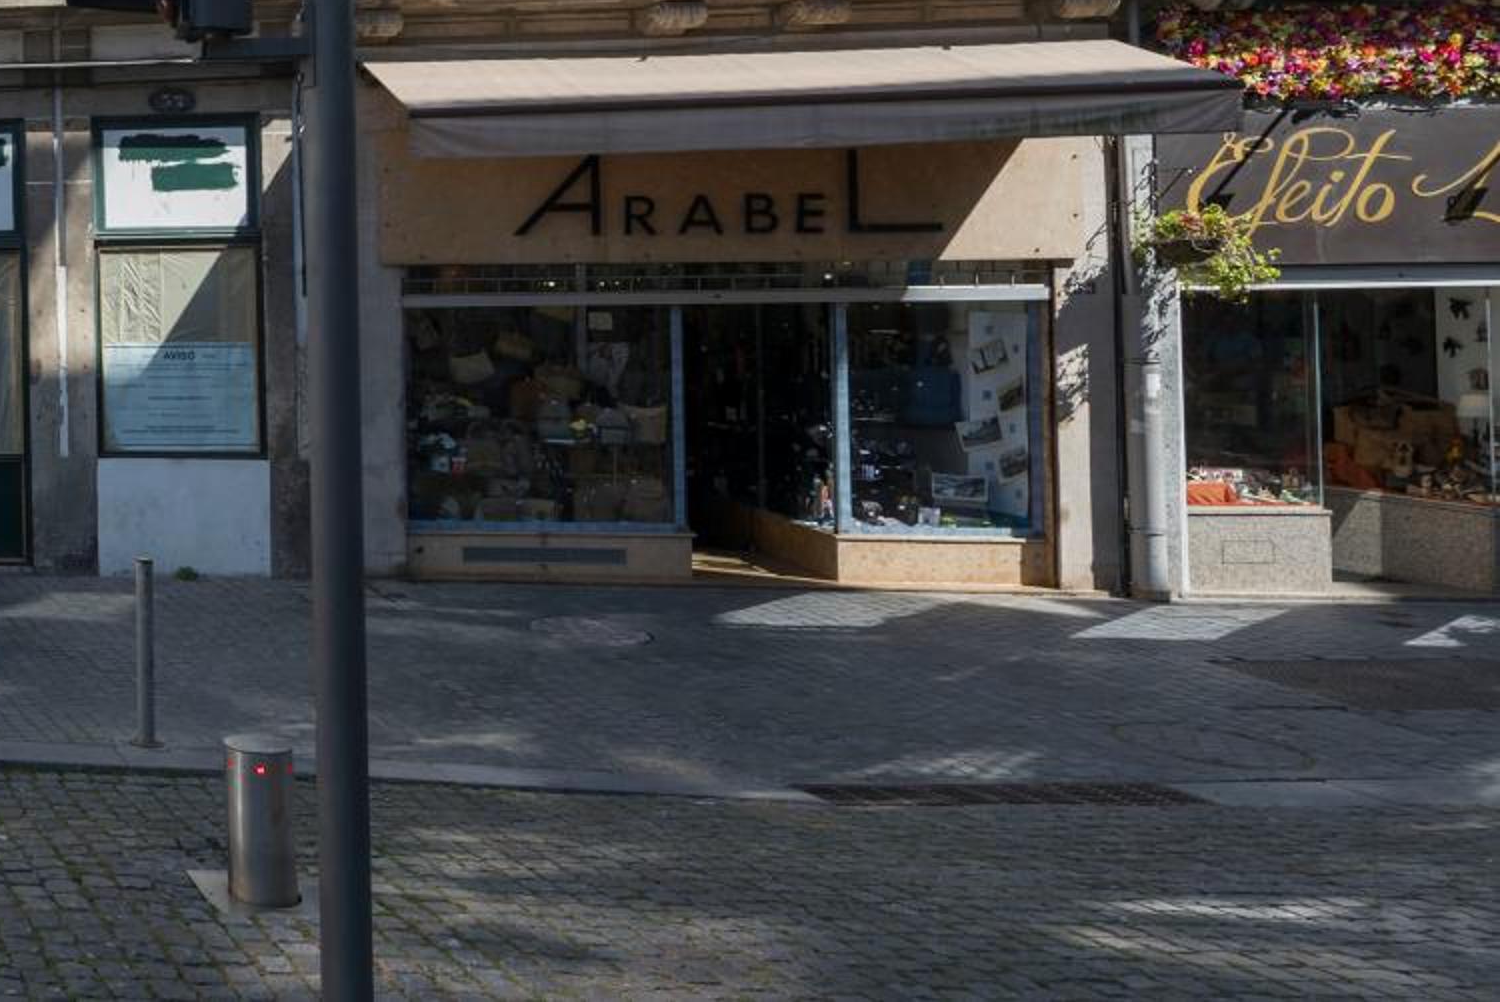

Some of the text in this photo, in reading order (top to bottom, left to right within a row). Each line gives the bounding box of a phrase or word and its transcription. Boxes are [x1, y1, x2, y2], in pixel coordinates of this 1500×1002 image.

[514, 149, 943, 236] ARABEL
[1187, 127, 1412, 236] Efeito
[163, 350, 196, 361] AVISO
